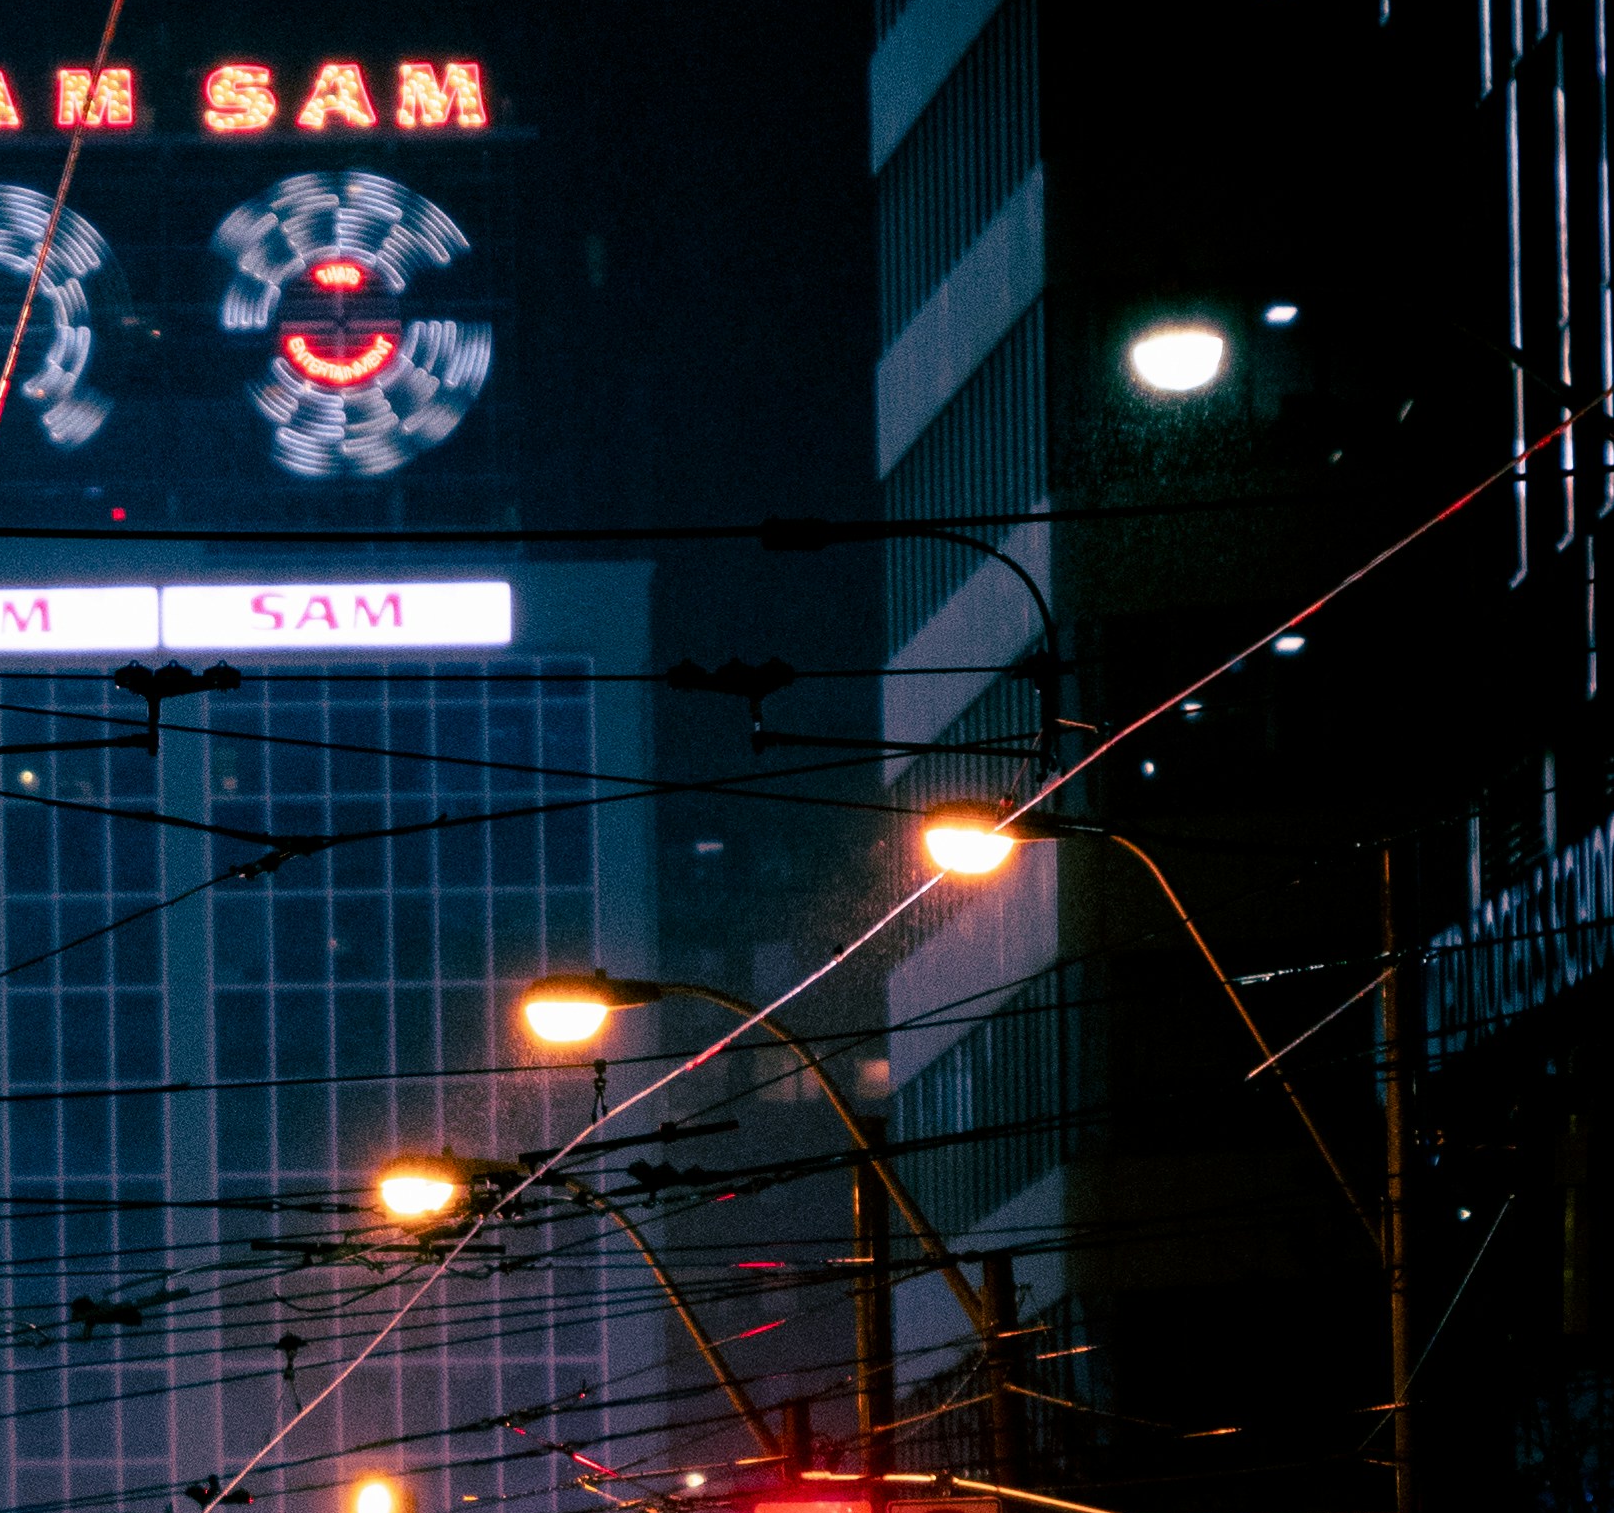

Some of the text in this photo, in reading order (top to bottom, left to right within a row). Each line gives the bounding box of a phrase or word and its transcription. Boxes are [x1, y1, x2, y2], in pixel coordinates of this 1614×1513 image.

[203, 59, 489, 132] SAM
[288, 335, 394, 381] ENTERTAINMENT
[248, 590, 406, 633] SAM
[1549, 809, 1614, 998] SCHO
